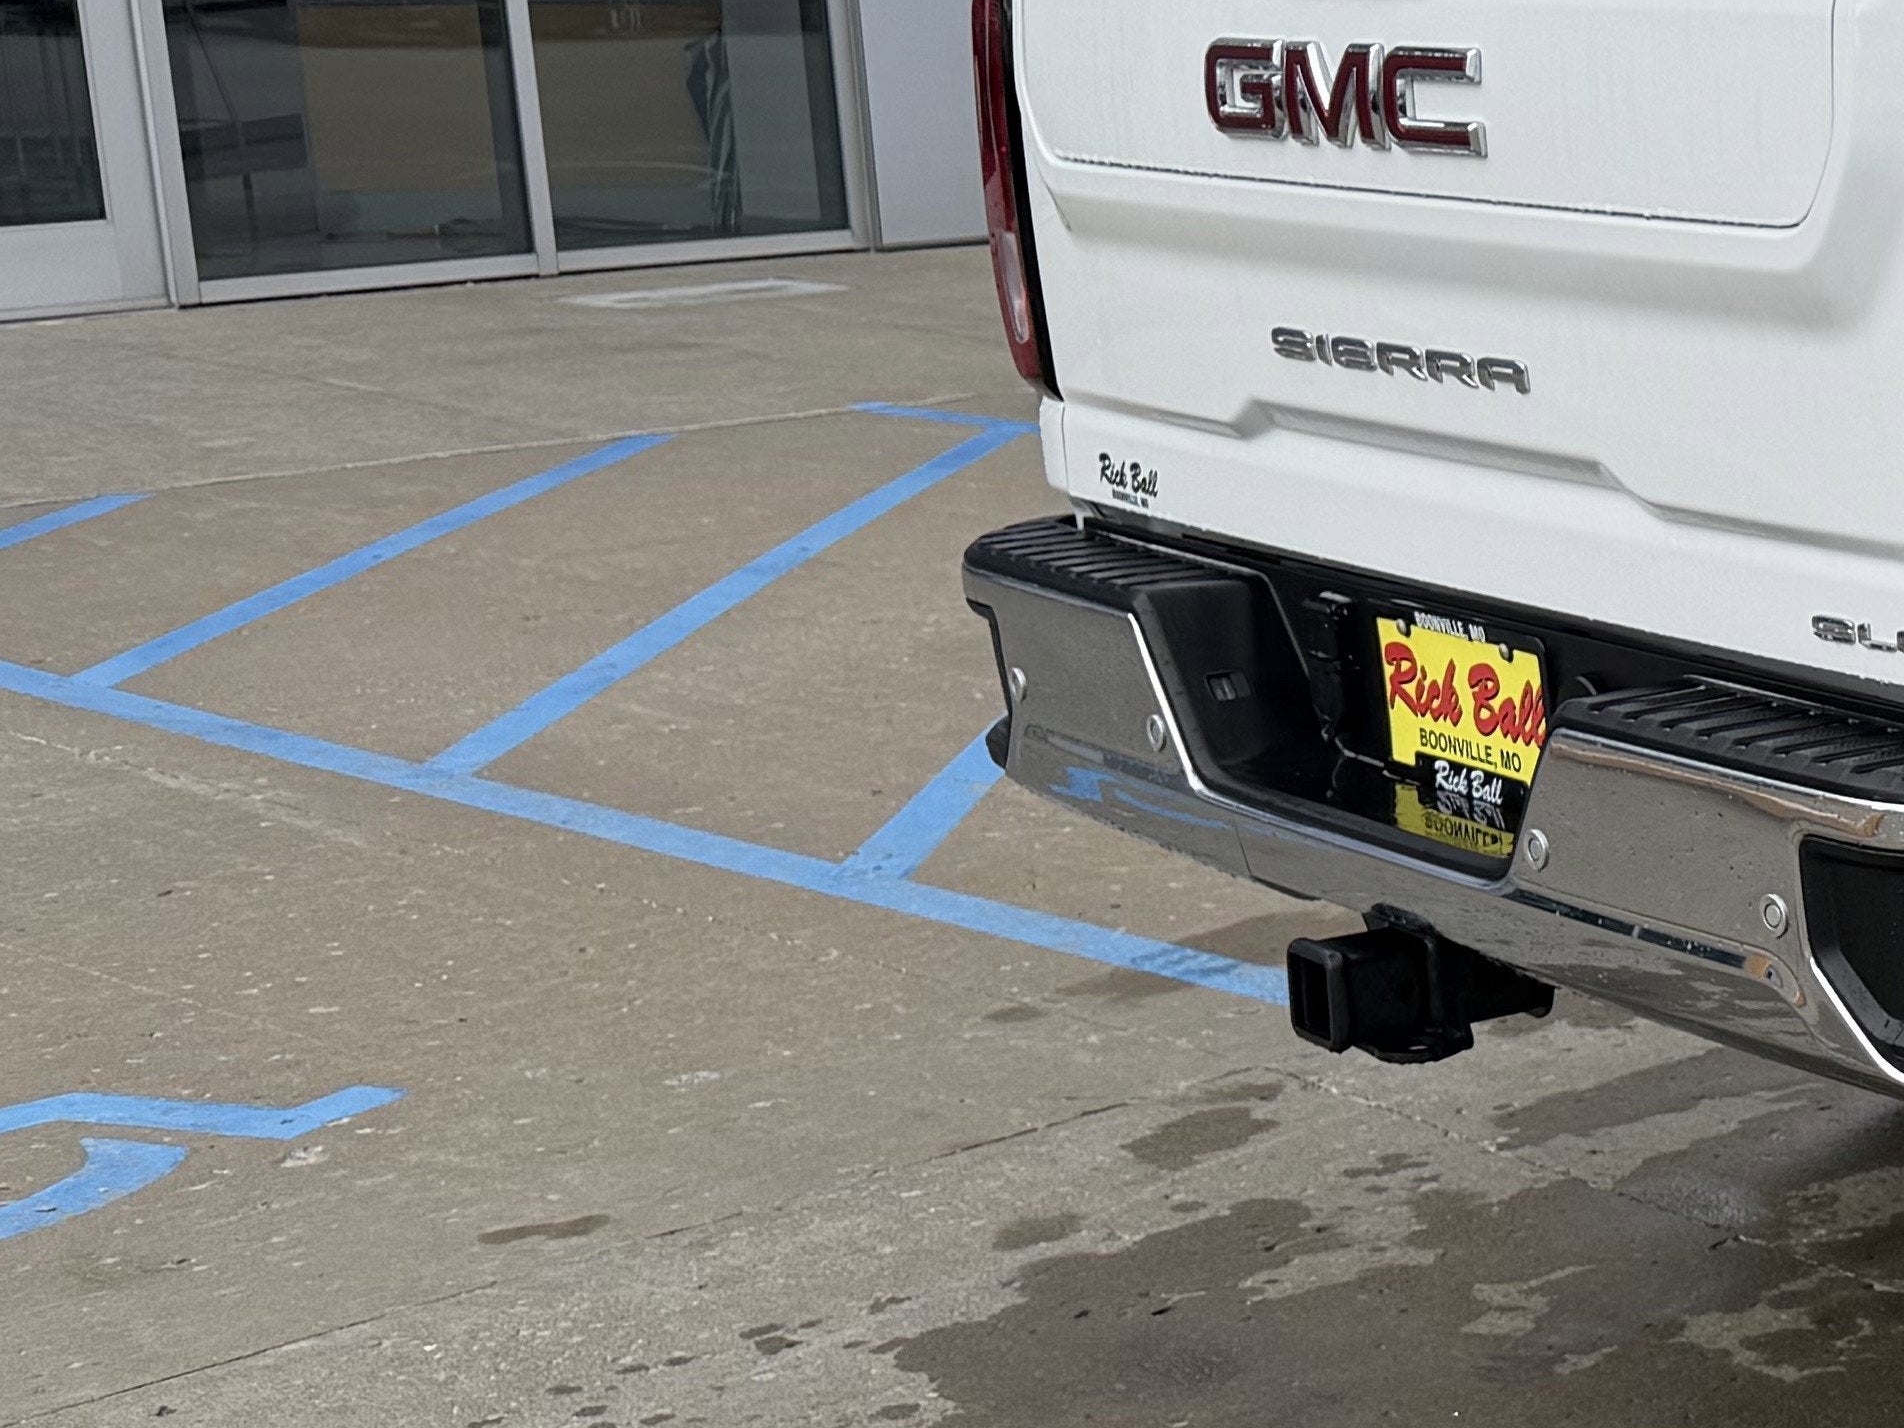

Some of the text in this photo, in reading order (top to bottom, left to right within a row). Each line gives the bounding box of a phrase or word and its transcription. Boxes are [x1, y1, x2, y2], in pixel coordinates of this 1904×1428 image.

[1204, 36, 1488, 160] GMC
[1270, 325, 1532, 396] SIERRA
[1098, 452, 1158, 498] Rick Ball
[1469, 622, 1486, 644] MO
[1384, 641, 1547, 748] Rick Ball
[1419, 727, 1522, 773] BOONVILLE, MO
[1434, 759, 1503, 806] Rick Ball
